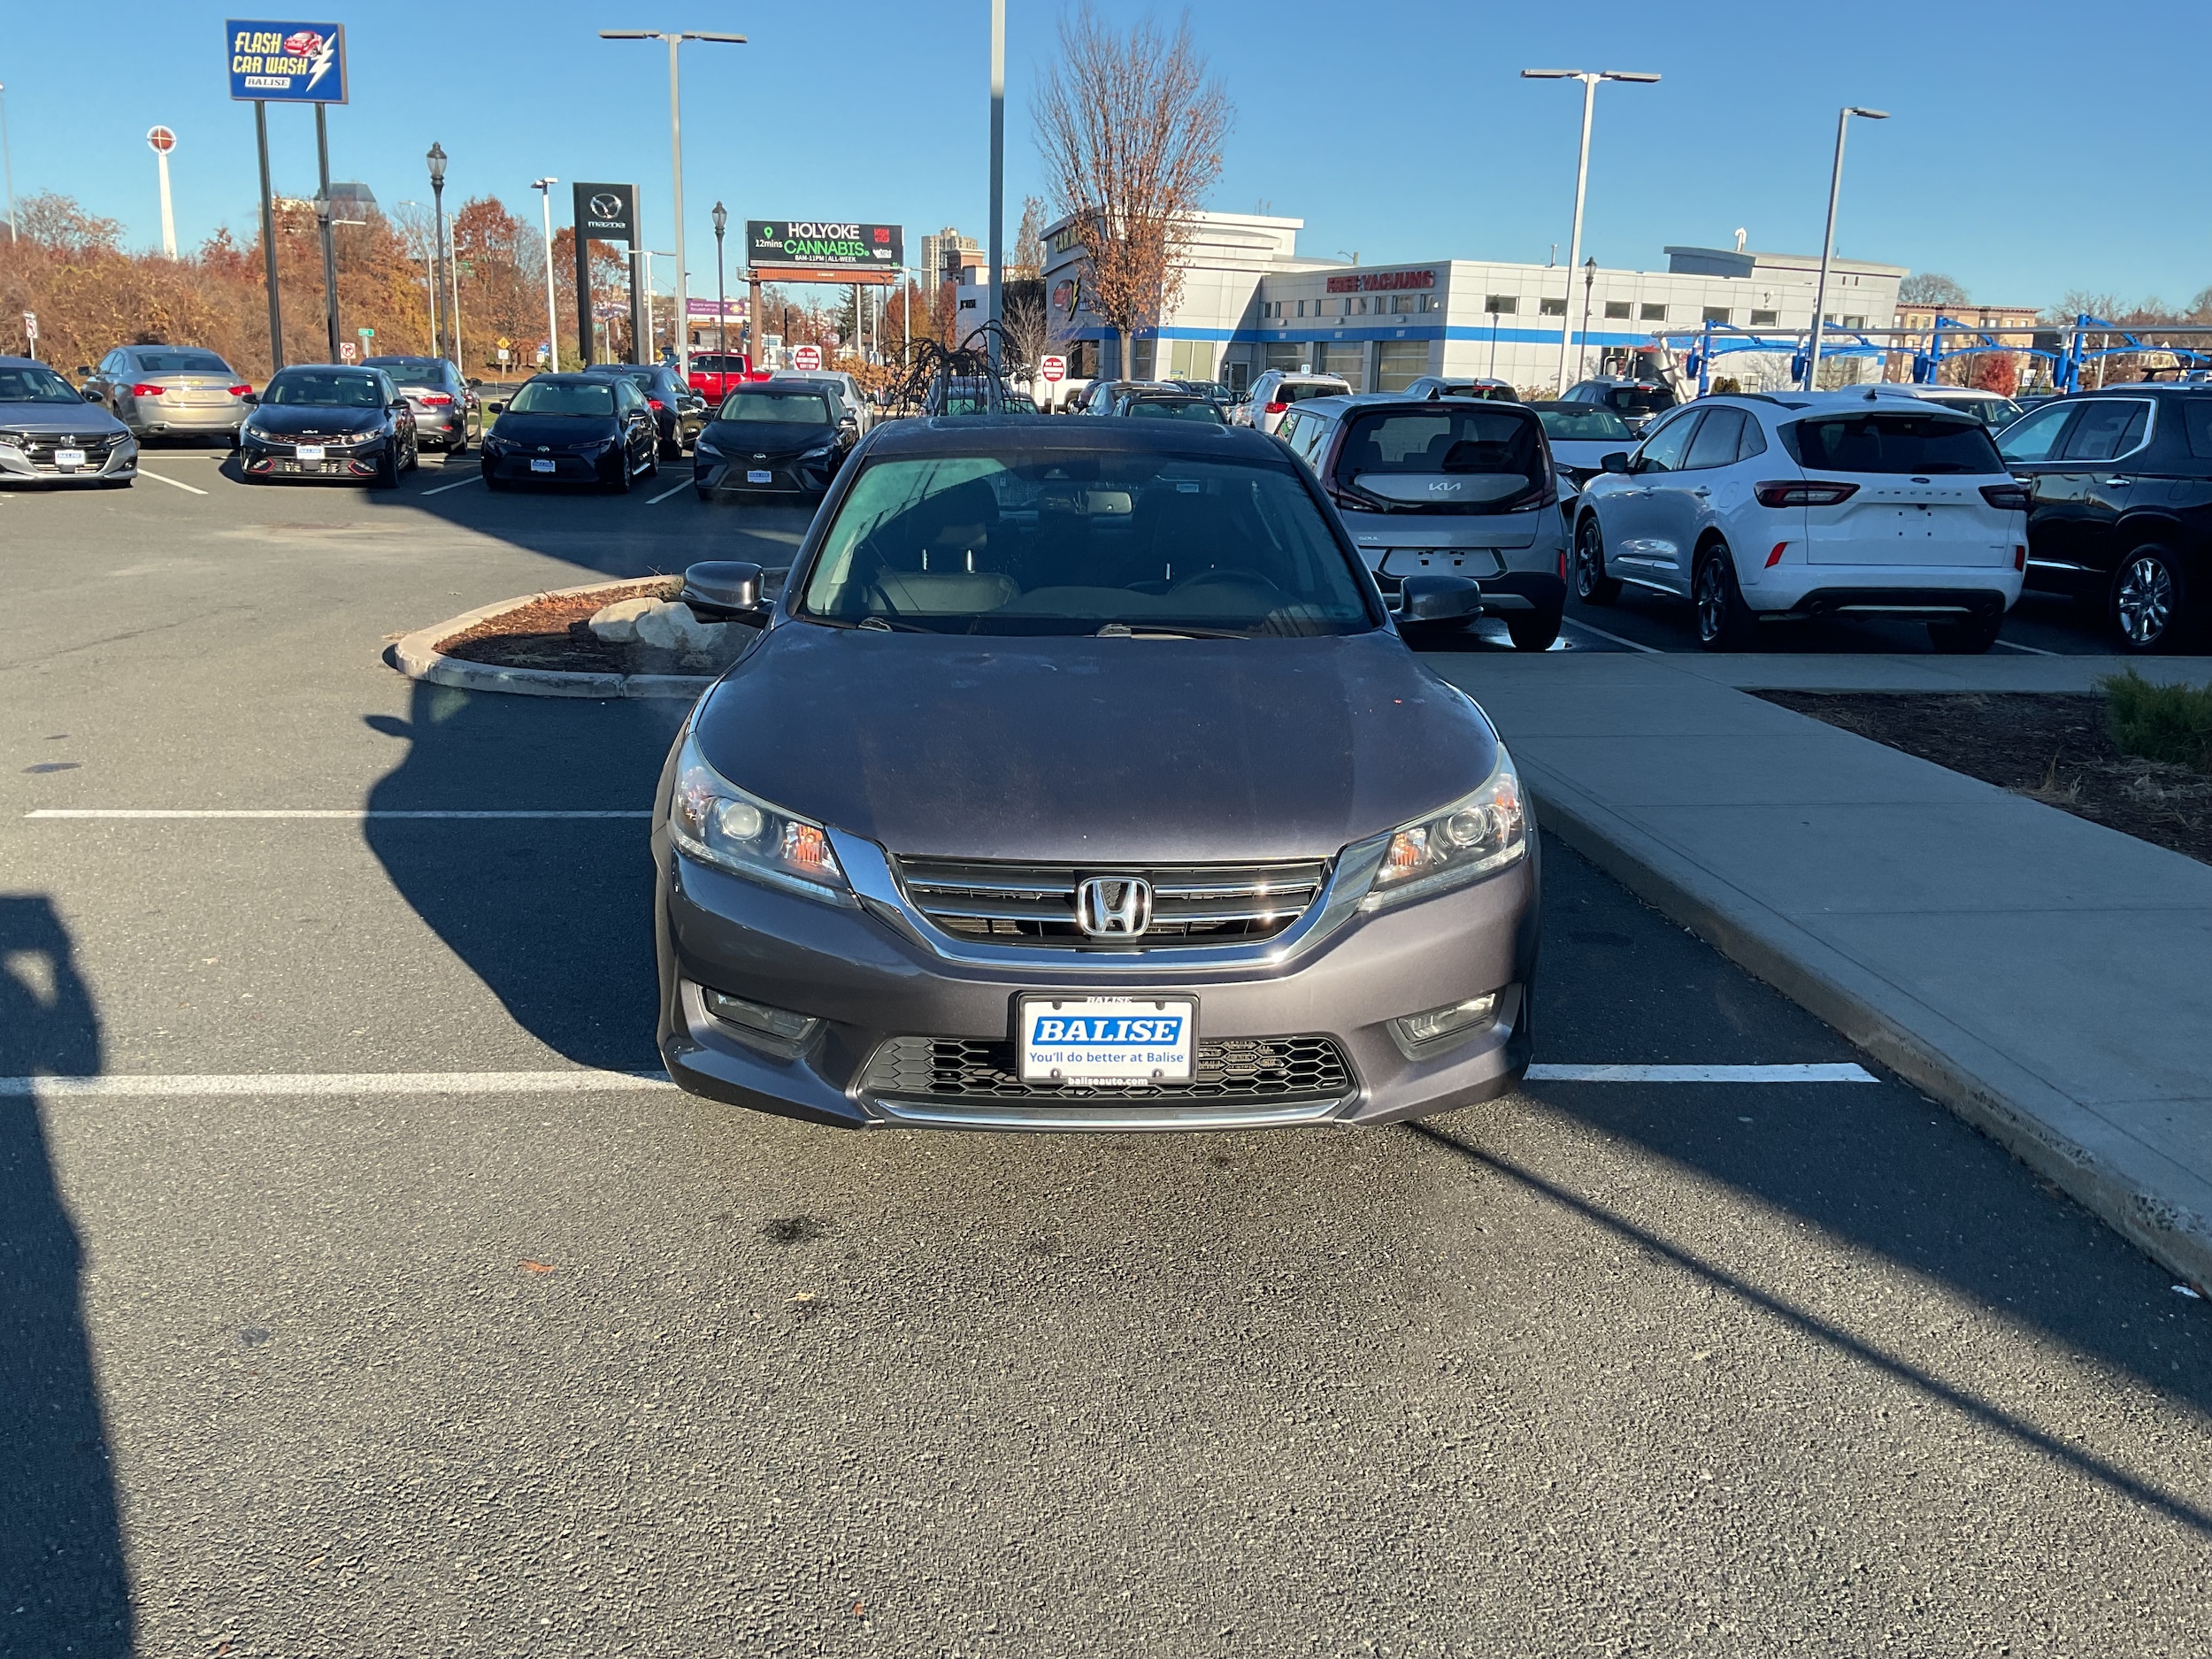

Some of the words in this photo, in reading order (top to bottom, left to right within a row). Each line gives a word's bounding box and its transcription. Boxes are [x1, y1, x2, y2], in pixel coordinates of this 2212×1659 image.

[234, 32, 281, 54] FLASH
[233, 56, 262, 73] CAR
[265, 57, 308, 74] WASH
[248, 77, 288, 87] BALISE
[788, 223, 860, 239] HOLYOKE
[756, 239, 782, 249] 12mins
[1326, 276, 1359, 293] FREE
[1363, 271, 1433, 291] VACUUMS
[1428, 482, 1462, 491] KIA
[1037, 1020, 1178, 1042] BALISE
[1030, 1052, 1063, 1063] You'll
[1067, 1052, 1083, 1063] do
[1087, 1052, 1126, 1063] better
[1130, 1053, 1143, 1063] at
[1147, 1052, 1184, 1063] Balise
[1068, 1077, 1148, 1086] baliseauto.com
